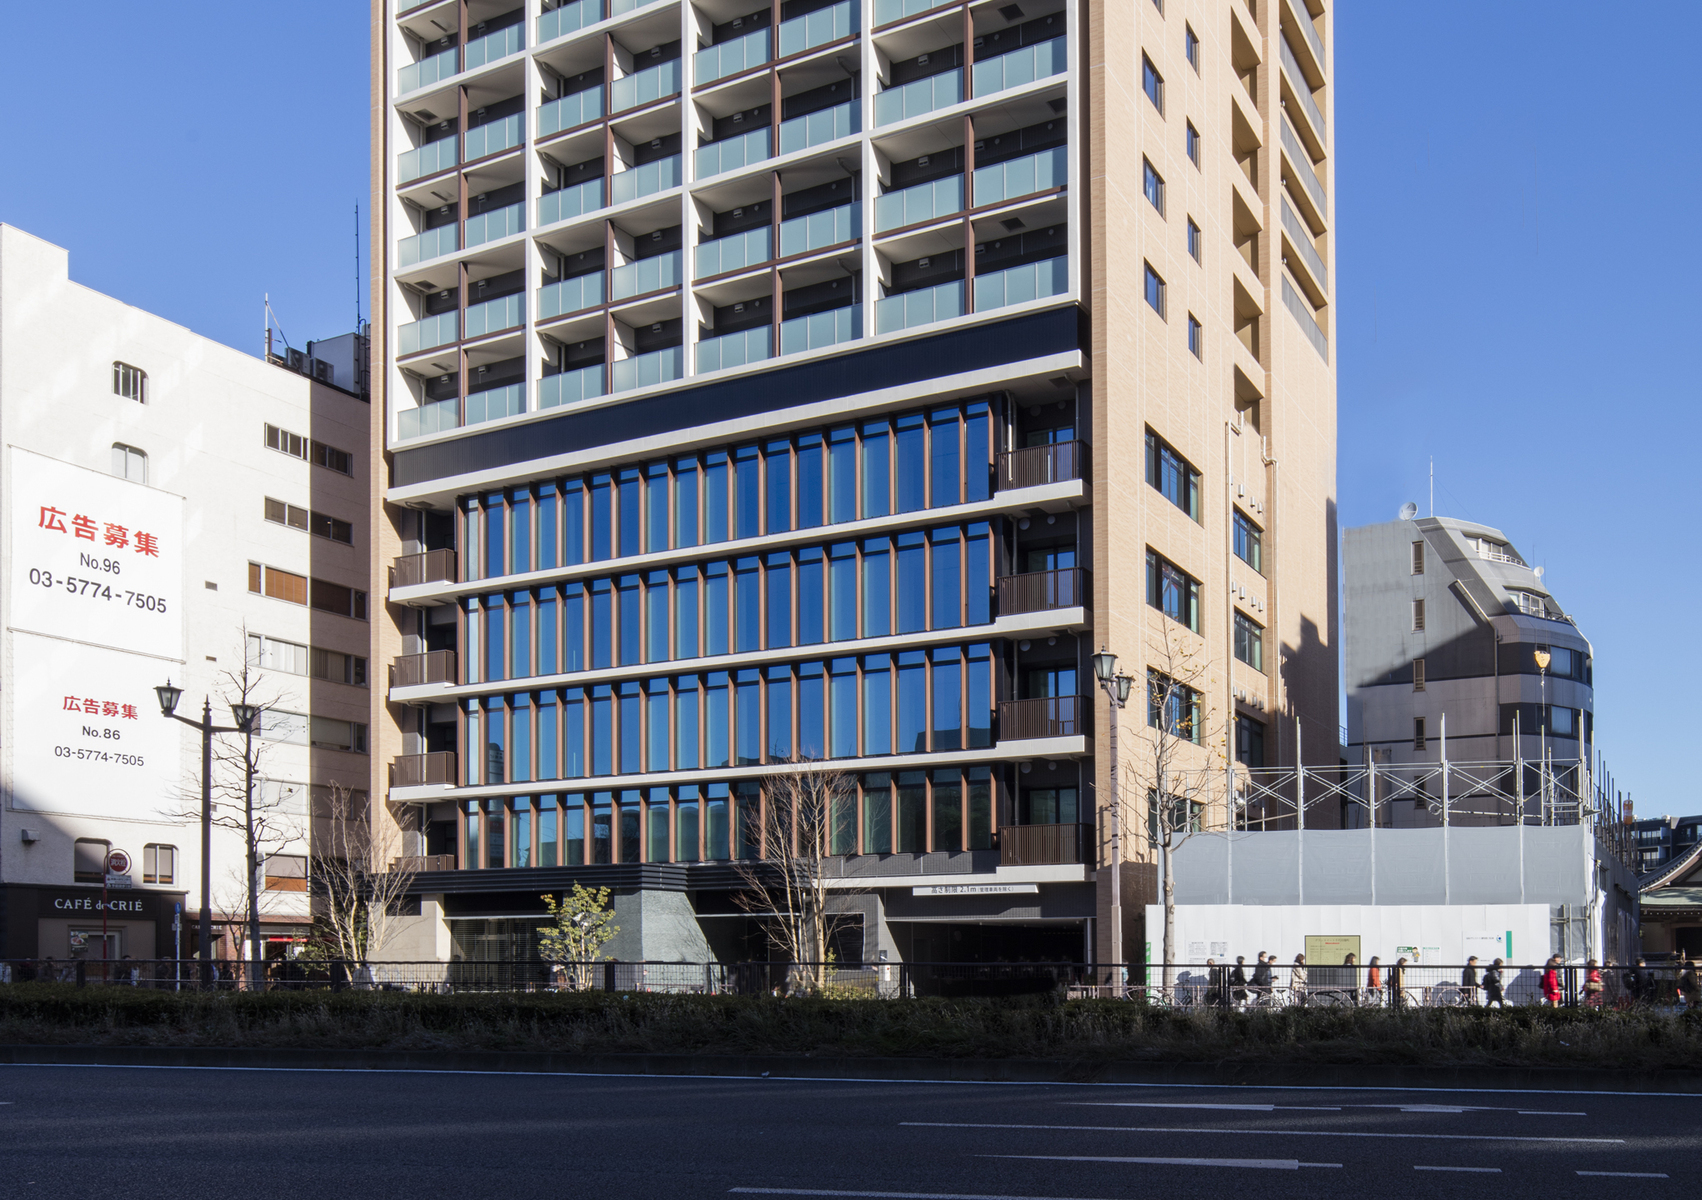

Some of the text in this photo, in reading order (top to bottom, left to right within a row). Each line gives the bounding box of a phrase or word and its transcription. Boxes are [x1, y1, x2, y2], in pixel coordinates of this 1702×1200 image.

[38, 506, 160, 558] 広告募集
[80, 552, 121, 575] No.96
[29, 568, 167, 614] 03-5774-7505
[62, 695, 138, 721] 広告募集
[82, 725, 121, 741] No.86
[54, 745, 145, 767] 03-5774-7505
[54, 897, 93, 910] CAFÉ
[110, 899, 143, 911] CRIÉ
